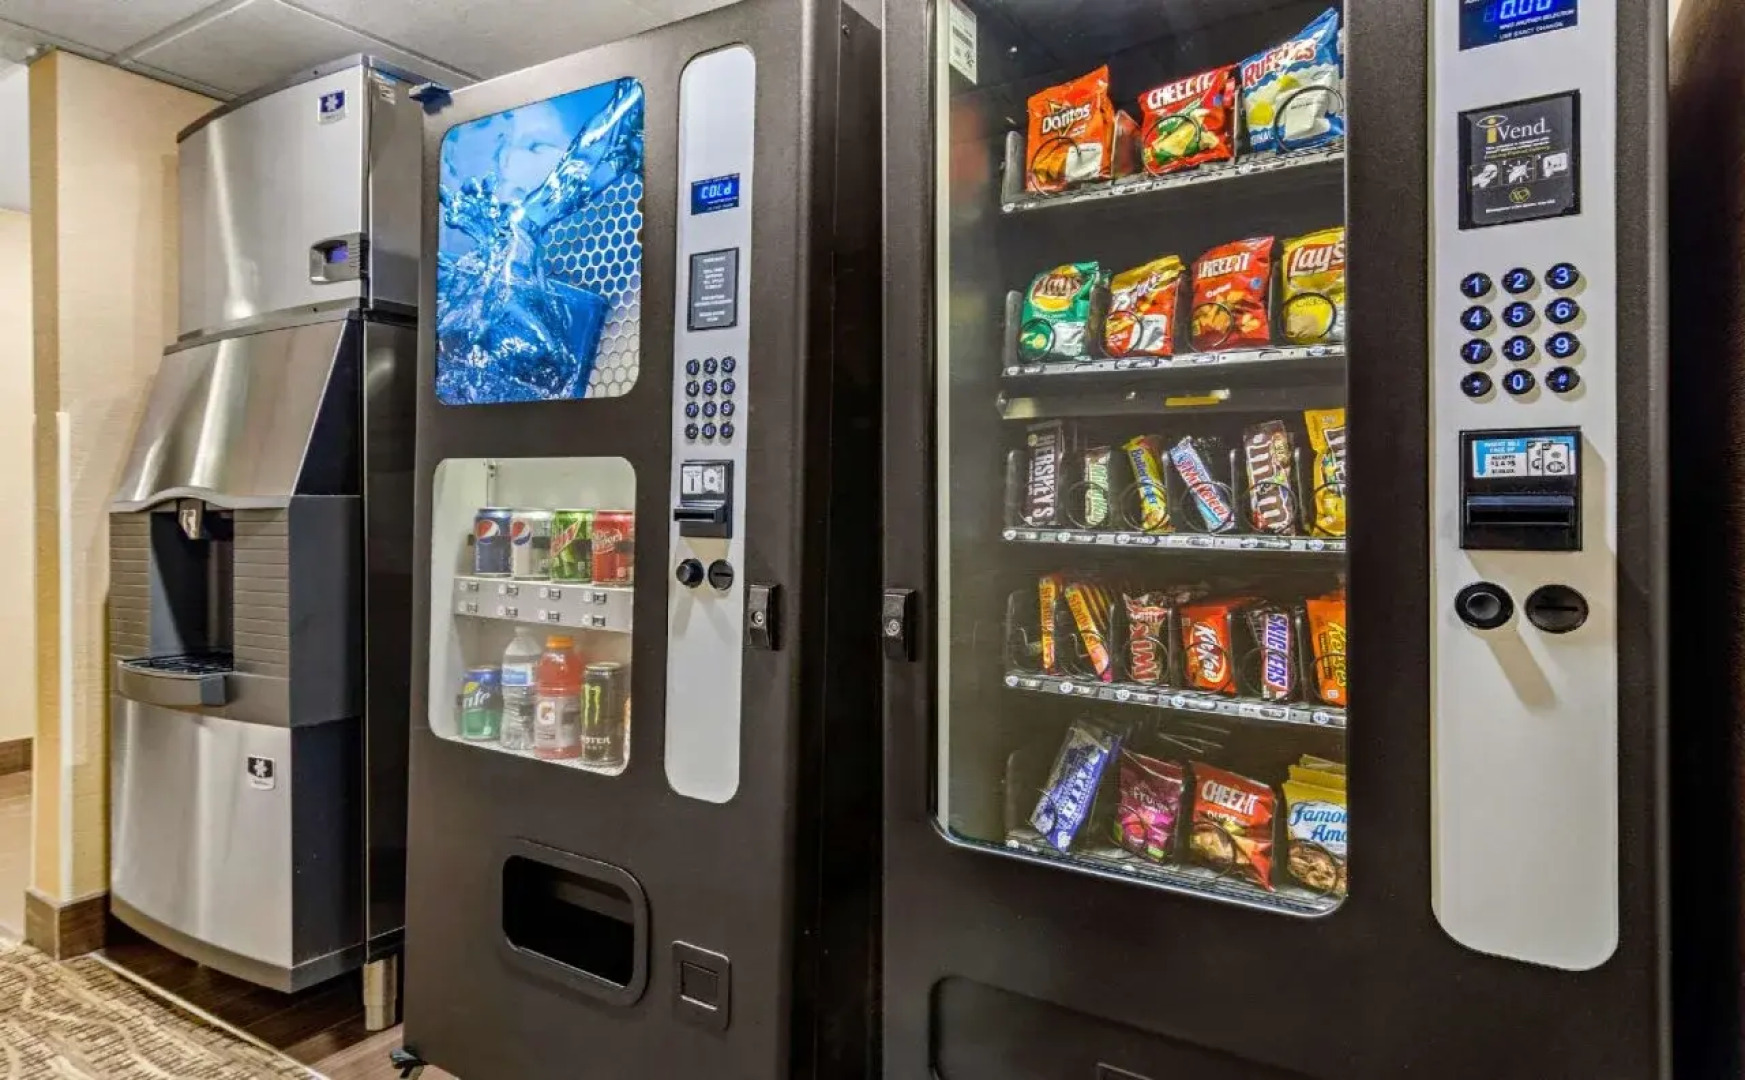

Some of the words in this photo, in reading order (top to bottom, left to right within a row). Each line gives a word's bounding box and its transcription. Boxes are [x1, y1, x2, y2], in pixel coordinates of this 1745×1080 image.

[1244, 40, 1316, 88] RUFFLES
[1042, 103, 1091, 134] Doritos
[1469, 277, 1480, 293] 1
[1513, 273, 1525, 288] 2
[1556, 267, 1569, 284] 3
[1470, 310, 1482, 326] 4
[1512, 306, 1524, 322] 5
[1556, 302, 1569, 318] 6
[1471, 344, 1481, 360] 7
[1513, 340, 1525, 356] 8
[1556, 337, 1569, 353] 9
[1512, 375, 1524, 390] 0
[1033, 434, 1056, 519] HERSHEY'S
[1267, 613, 1288, 687] SNICKERS
